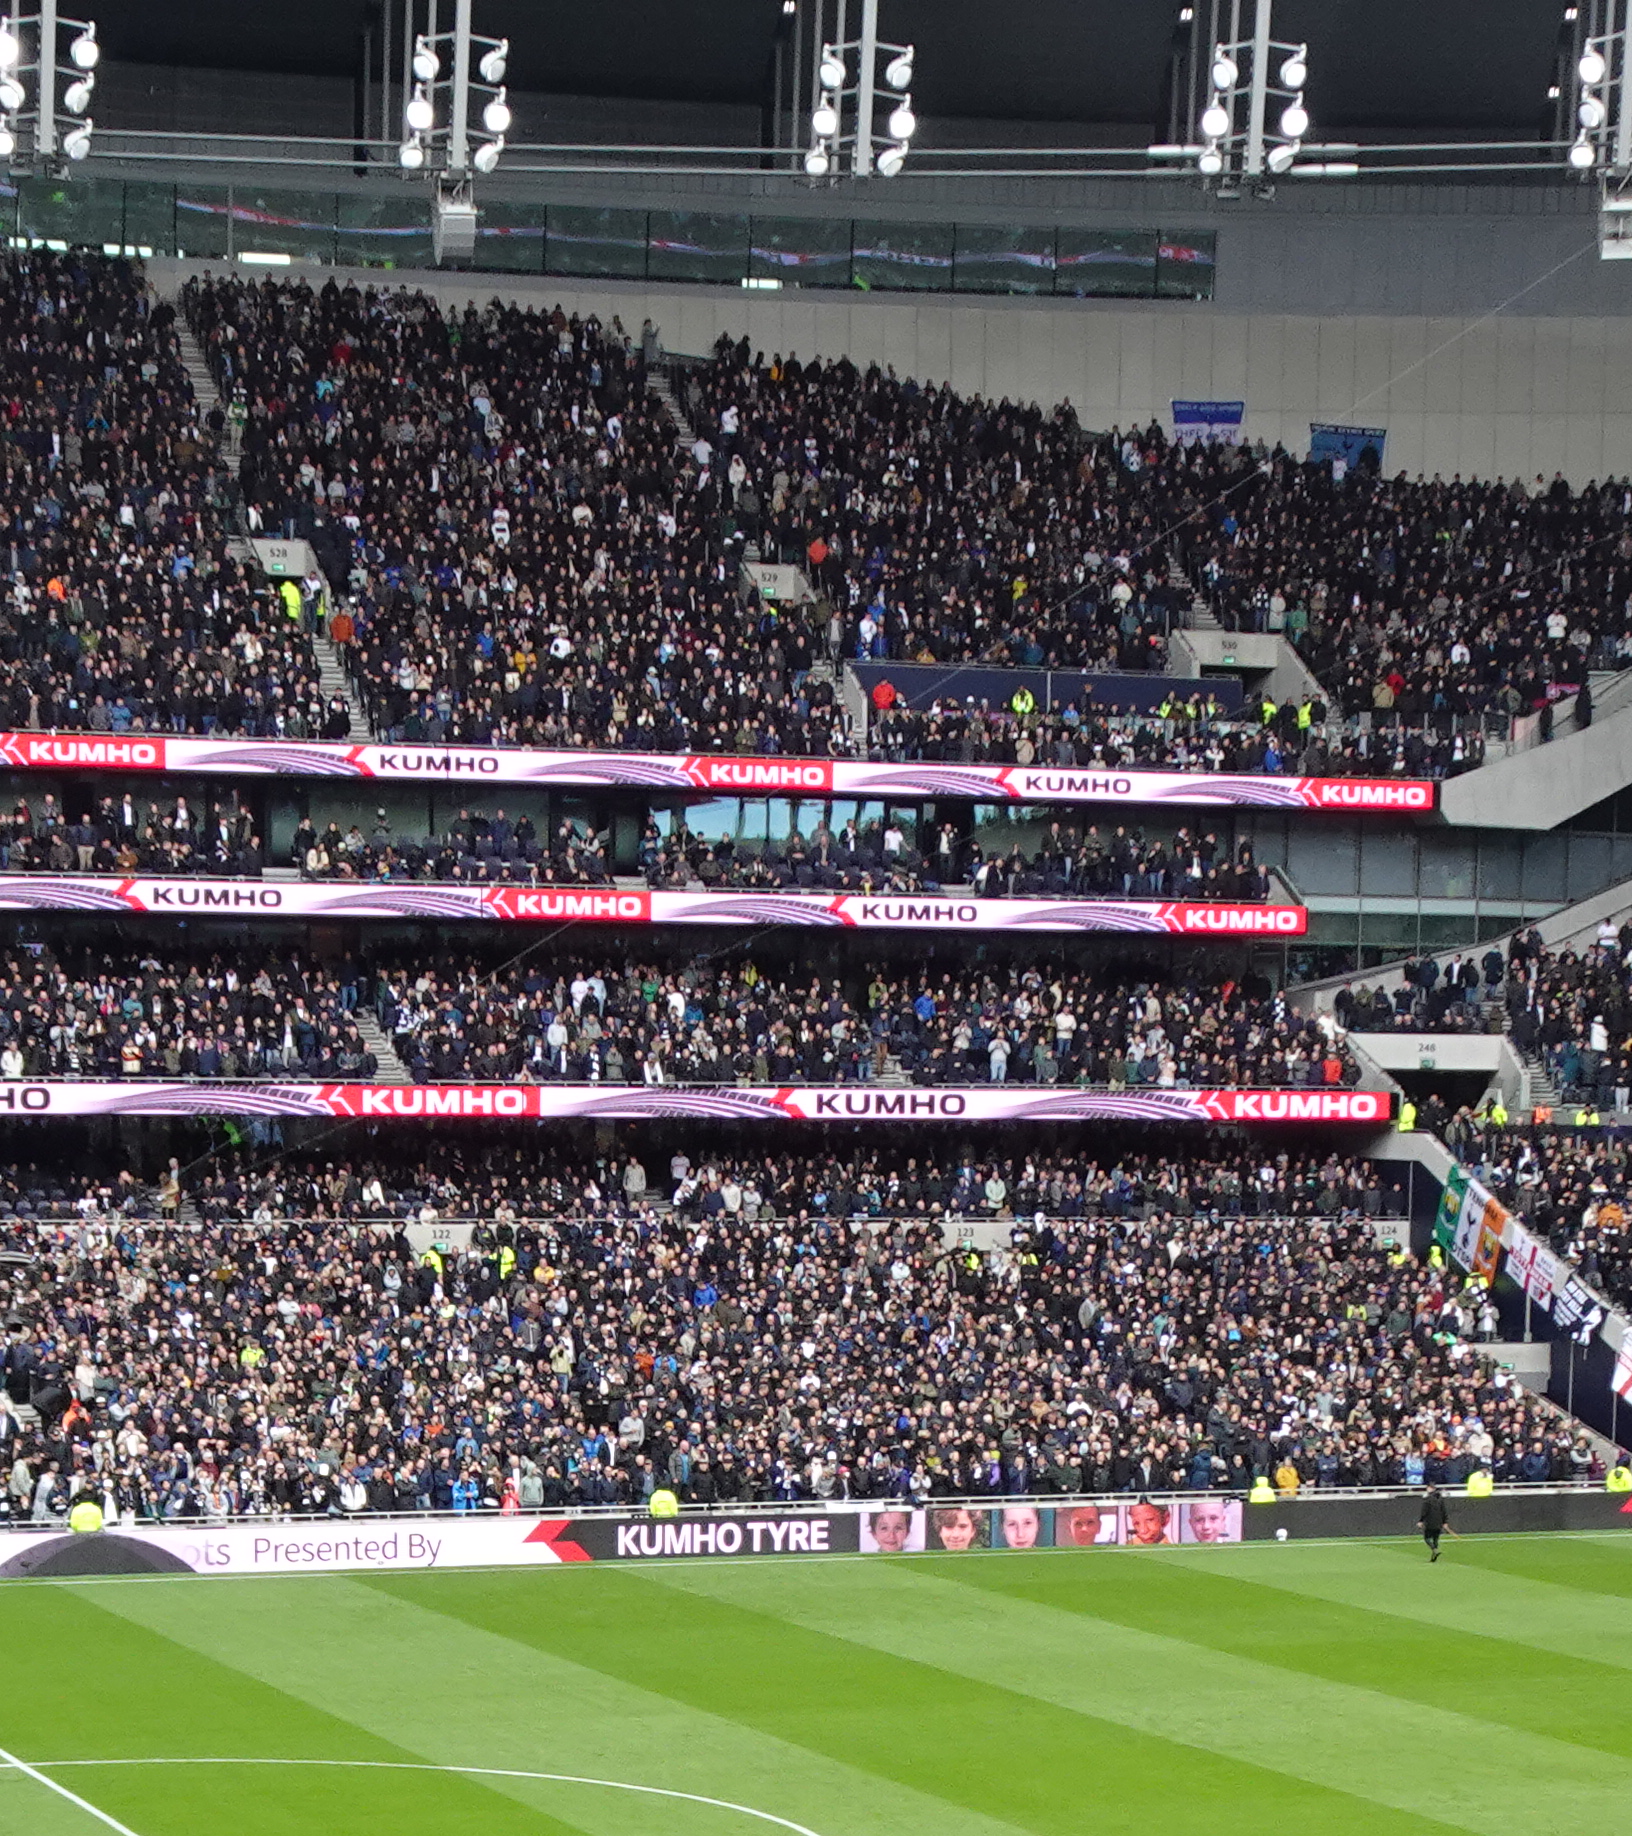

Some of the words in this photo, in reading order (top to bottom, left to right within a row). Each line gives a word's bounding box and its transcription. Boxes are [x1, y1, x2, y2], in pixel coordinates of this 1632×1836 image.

[29, 740, 157, 765] KUMHO
[380, 755, 498, 772] KUMHO
[710, 763, 825, 786] KUMHO
[1025, 775, 1131, 794] KUMHO
[1321, 784, 1426, 806] KUMHO
[153, 888, 282, 906] KUMHO
[517, 894, 643, 917] KUMHO
[863, 905, 977, 921] KUMHO
[1185, 909, 1298, 931] KUMHO
[361, 1088, 528, 1115] KUMHO
[817, 1094, 965, 1115] KUMHO
[1234, 1094, 1378, 1119] KUMHO
[432, 1229, 451, 1240] 122
[957, 1228, 974, 1238] 123
[617, 1523, 743, 1556] KUMHO
[747, 1520, 830, 1552] TYRE
[254, 1537, 401, 1564] Presented
[409, 1535, 442, 1567] By
